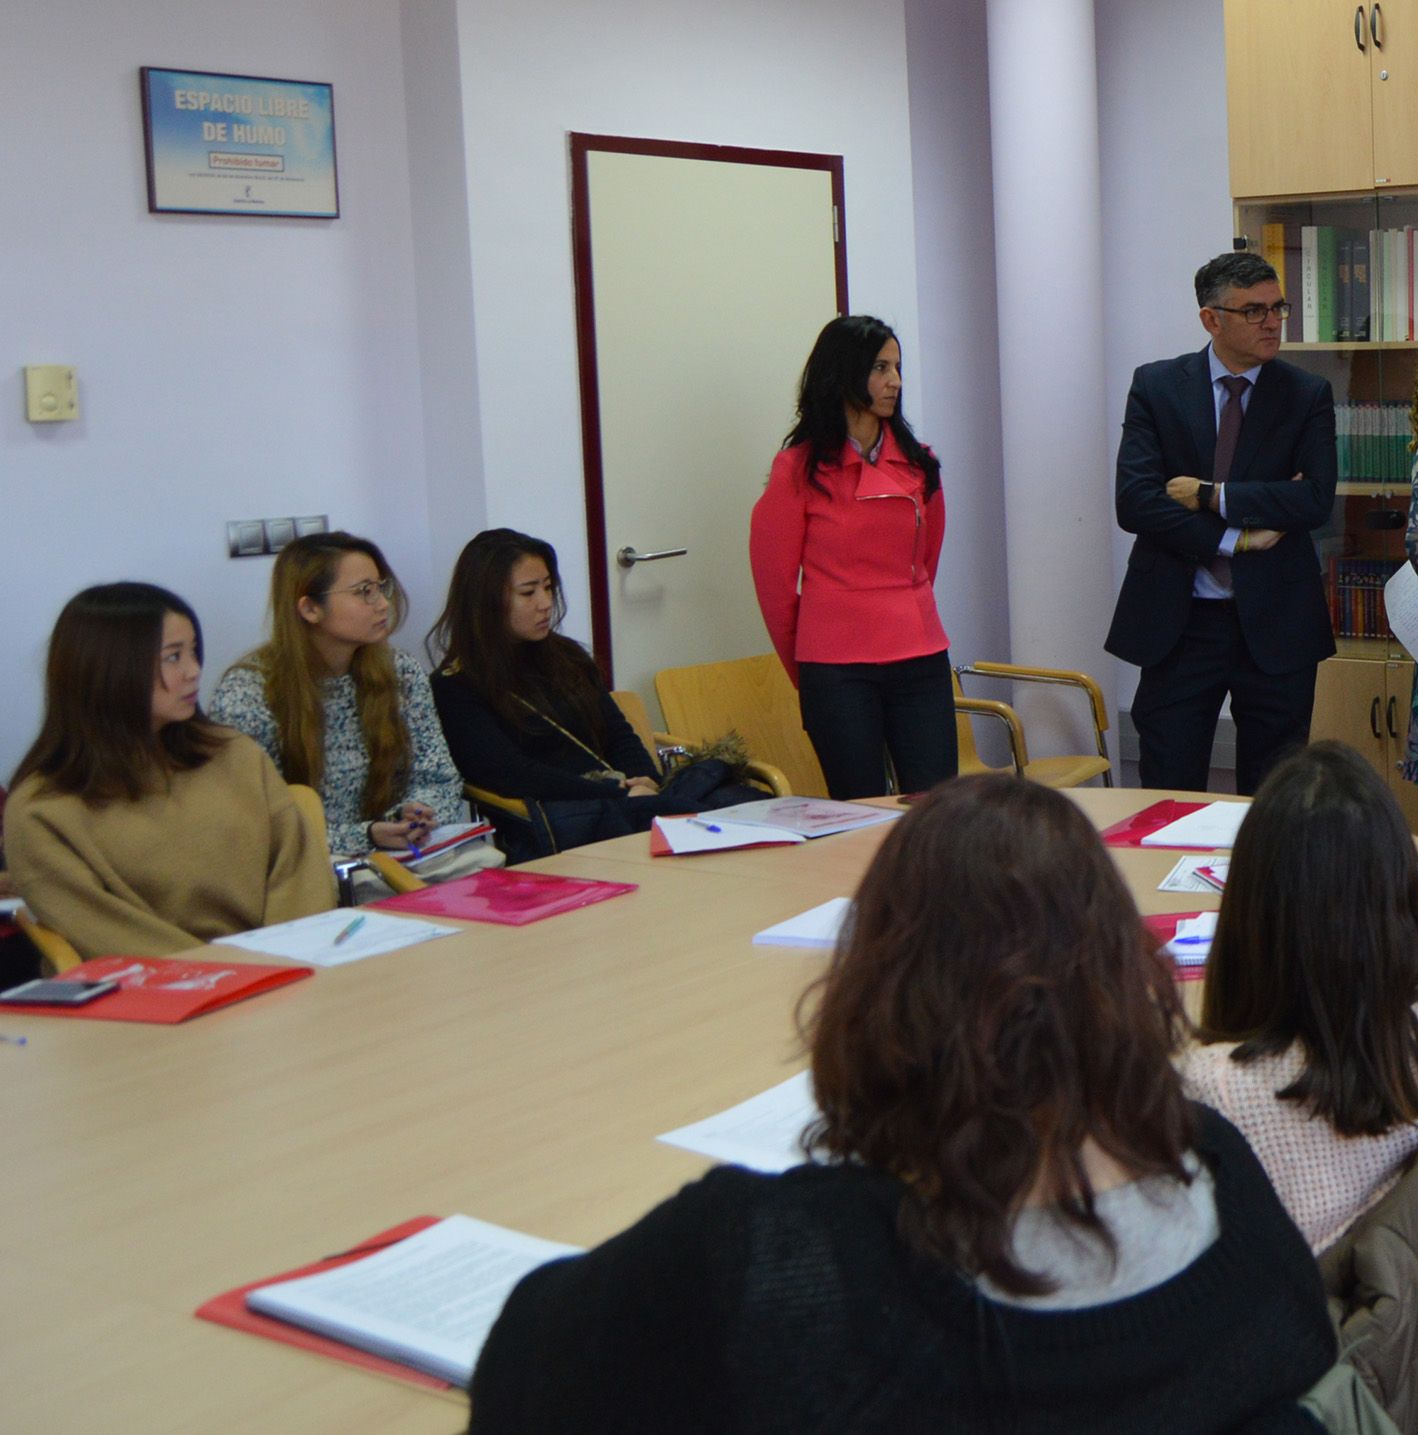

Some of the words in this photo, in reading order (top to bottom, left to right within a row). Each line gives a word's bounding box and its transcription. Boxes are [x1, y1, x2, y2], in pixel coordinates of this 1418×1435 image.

[174, 89, 253, 115] ESPACIO
[259, 97, 310, 119] LIBRE
[202, 121, 227, 142] DE
[233, 124, 286, 146] HUMO
